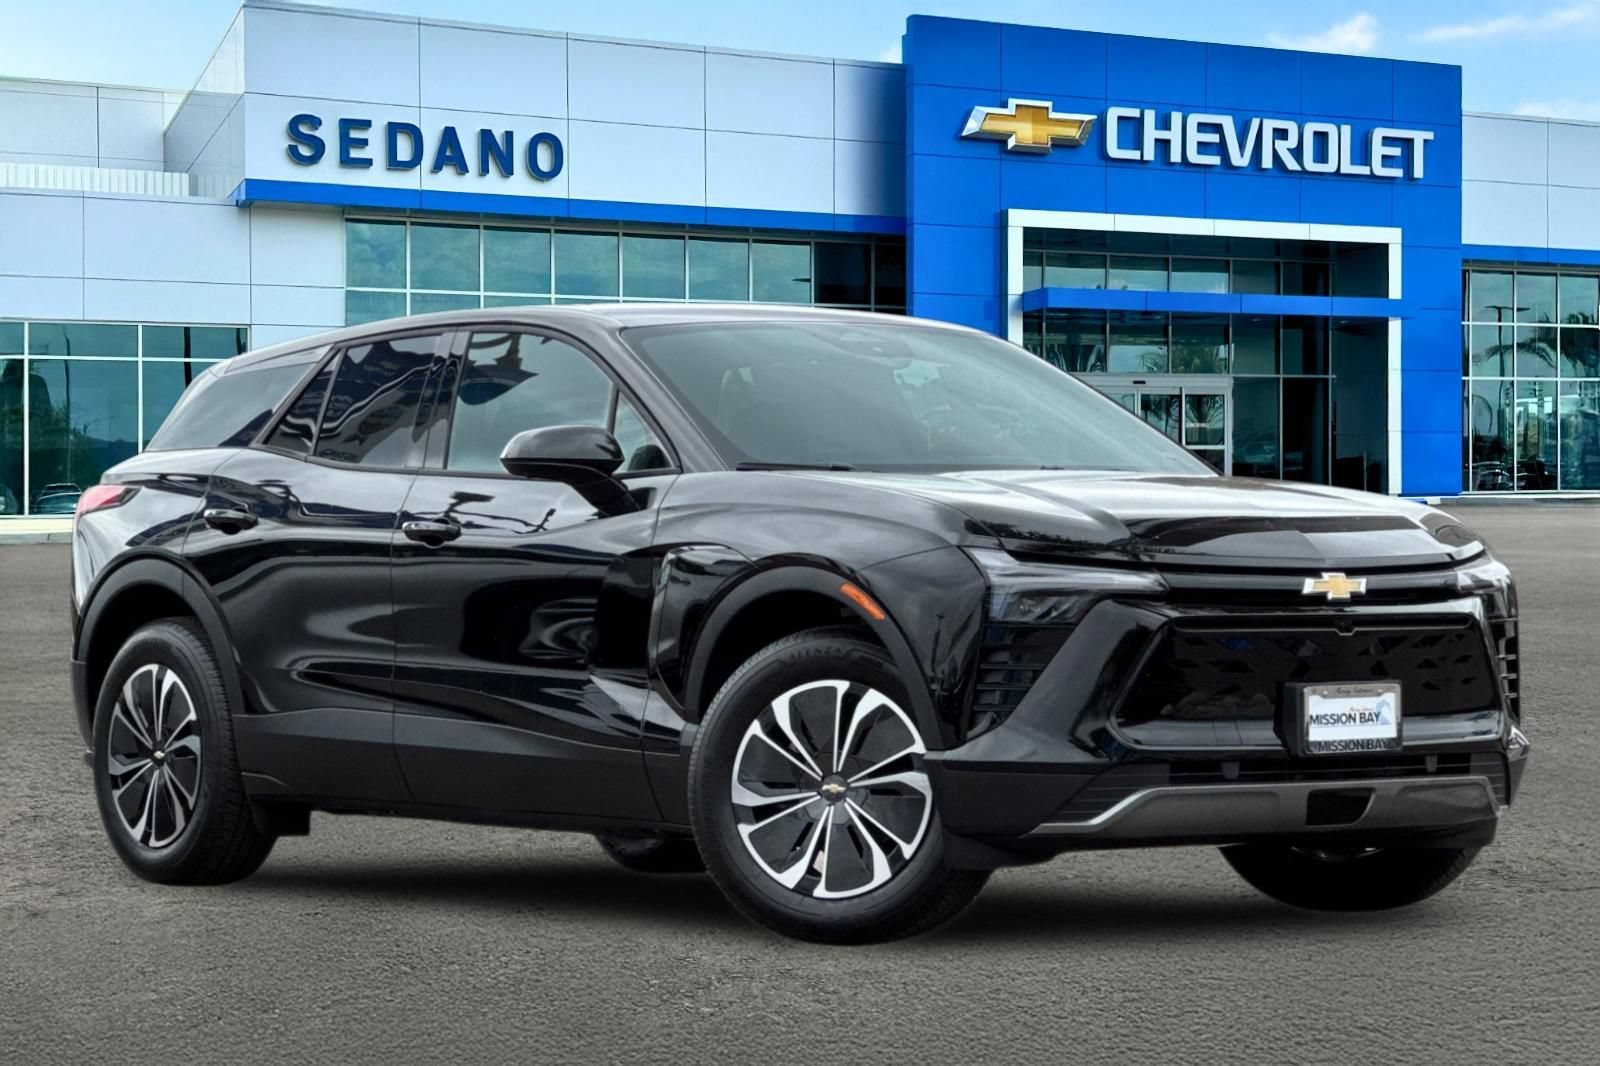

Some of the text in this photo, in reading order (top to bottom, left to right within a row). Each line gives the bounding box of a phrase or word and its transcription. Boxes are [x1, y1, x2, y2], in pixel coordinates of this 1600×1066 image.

[286, 113, 565, 182] SEDANO
[1105, 105, 1435, 180] CHEVROLET
[1310, 711, 1381, 726] MISSION BAY
[1319, 738, 1388, 752] MISSION BAY
